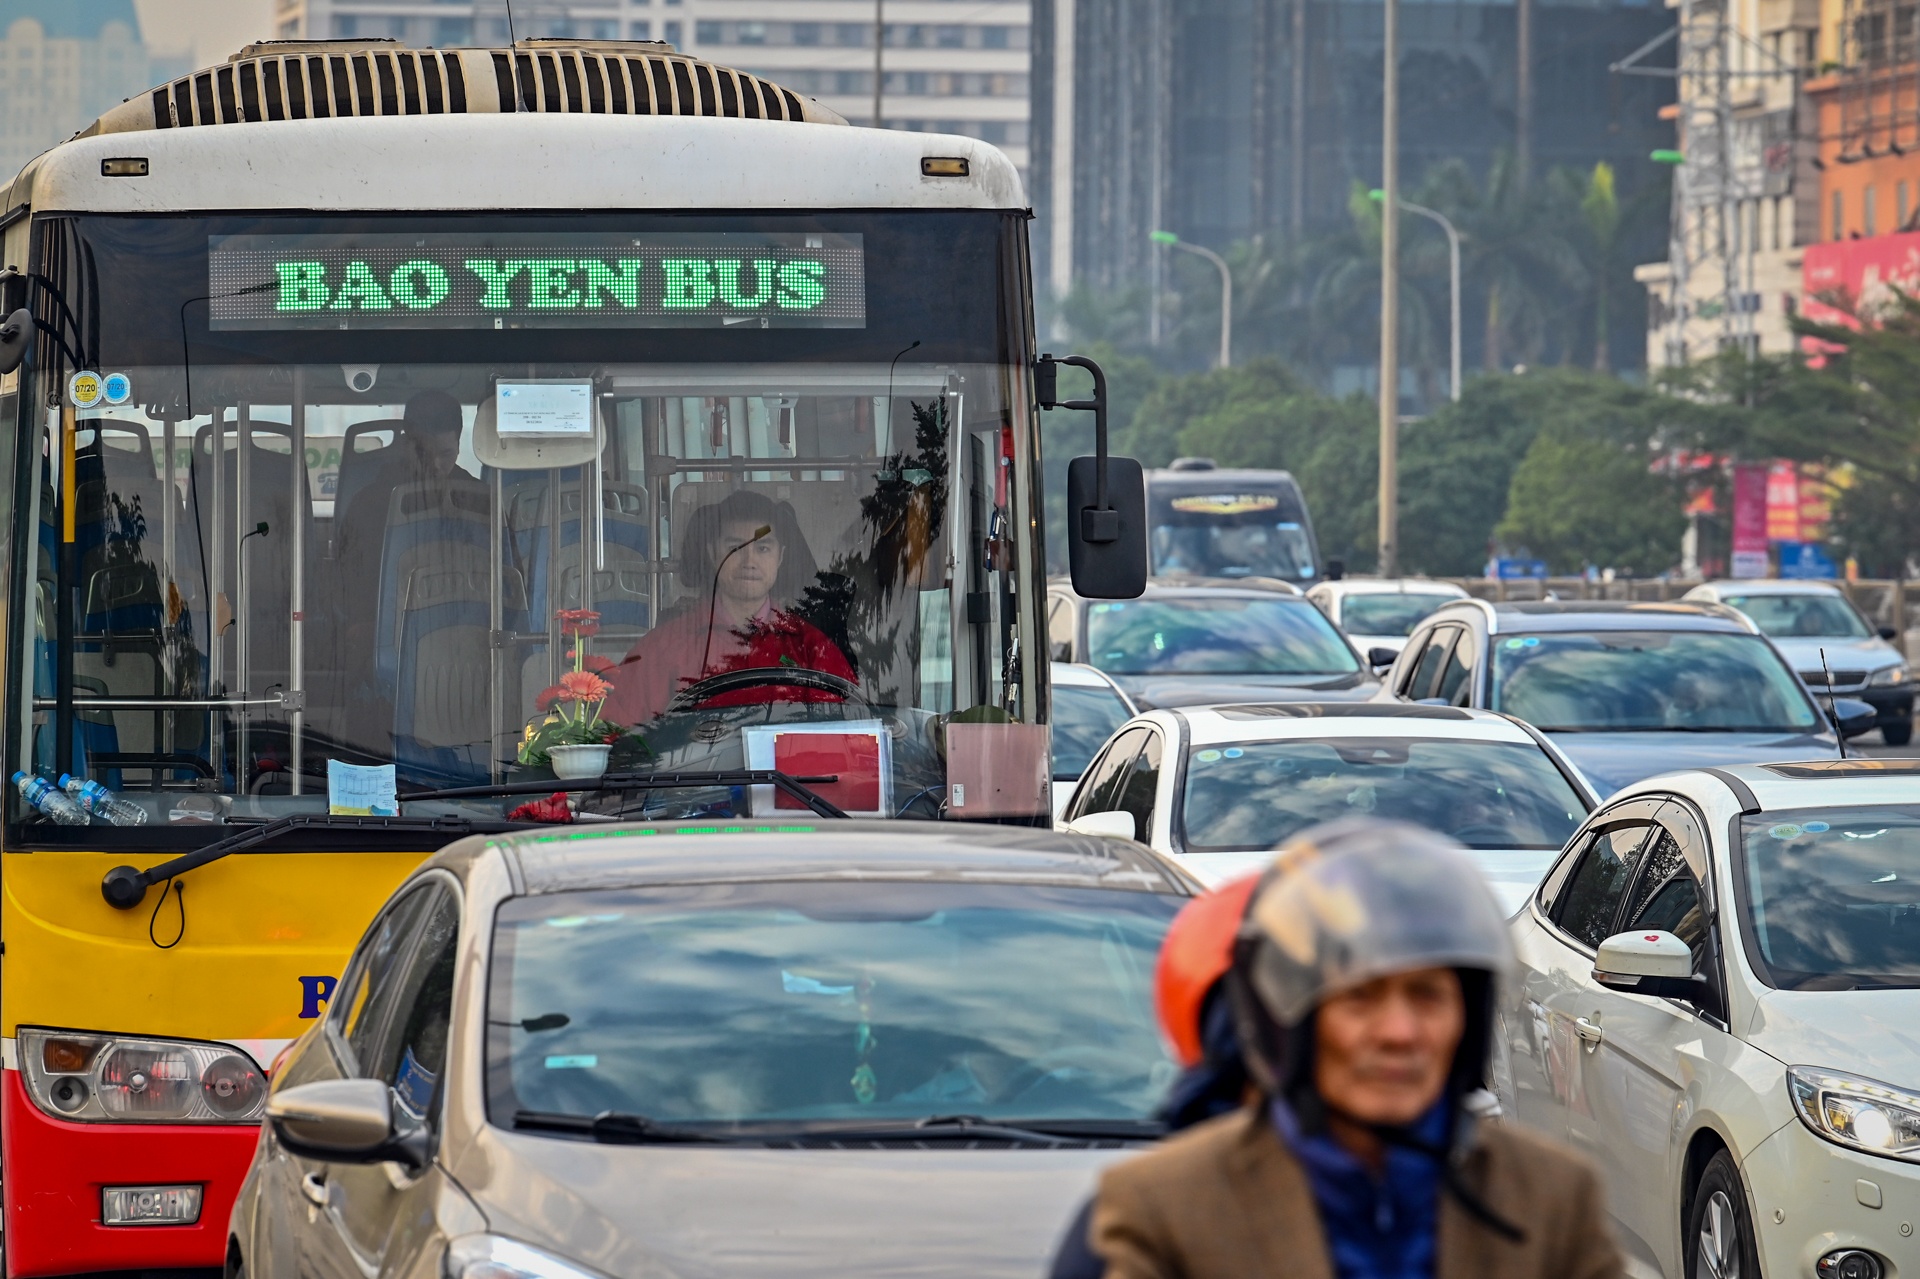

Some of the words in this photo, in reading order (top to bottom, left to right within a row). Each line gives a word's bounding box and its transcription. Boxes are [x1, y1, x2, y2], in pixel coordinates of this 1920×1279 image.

[275, 259, 450, 311] BAO
[464, 258, 643, 310] YEN
[660, 258, 825, 310] BUS
[75, 383, 96, 393] 07/20
[106, 382, 125, 391] 07/20
